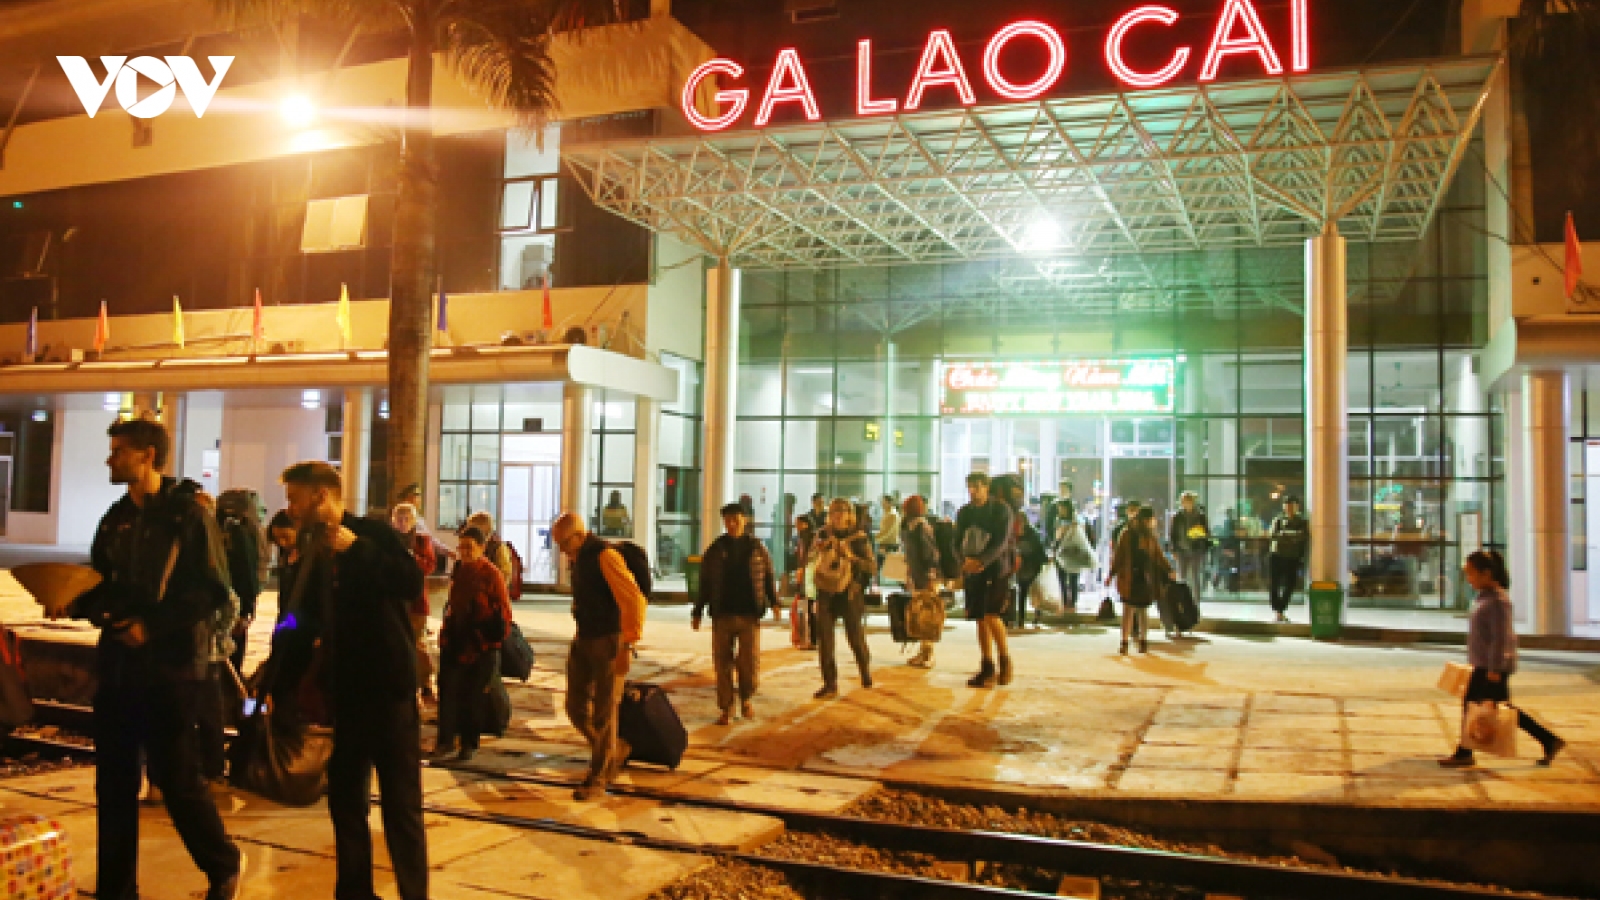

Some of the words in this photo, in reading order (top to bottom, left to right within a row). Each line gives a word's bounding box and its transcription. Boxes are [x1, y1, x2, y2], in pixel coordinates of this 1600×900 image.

[681, 47, 821, 131] GA
[855, 19, 1067, 116] LAO
[1104, 0, 1311, 87] CAI
